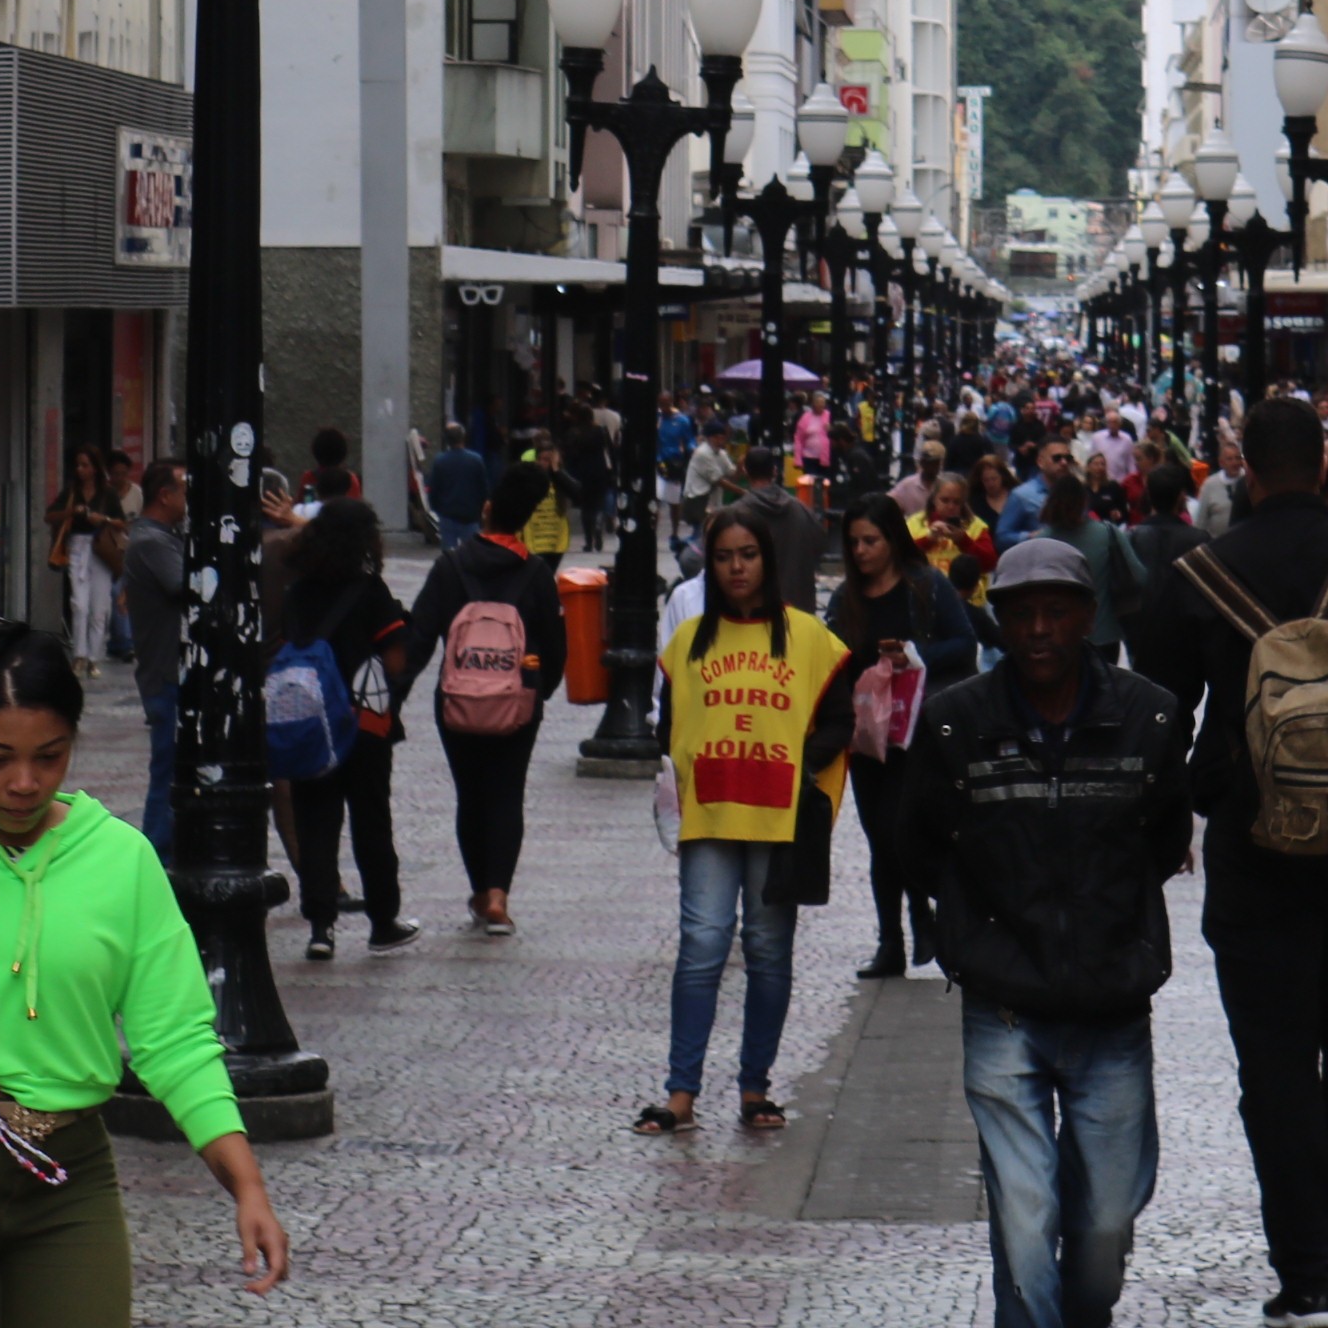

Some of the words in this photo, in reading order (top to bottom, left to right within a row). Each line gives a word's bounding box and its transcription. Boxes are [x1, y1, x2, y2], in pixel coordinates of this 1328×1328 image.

[454, 647, 516, 671] VANS
[700, 651, 796, 688] COMPRA-SE
[704, 688, 791, 711] OURO
[735, 714, 753, 732] E
